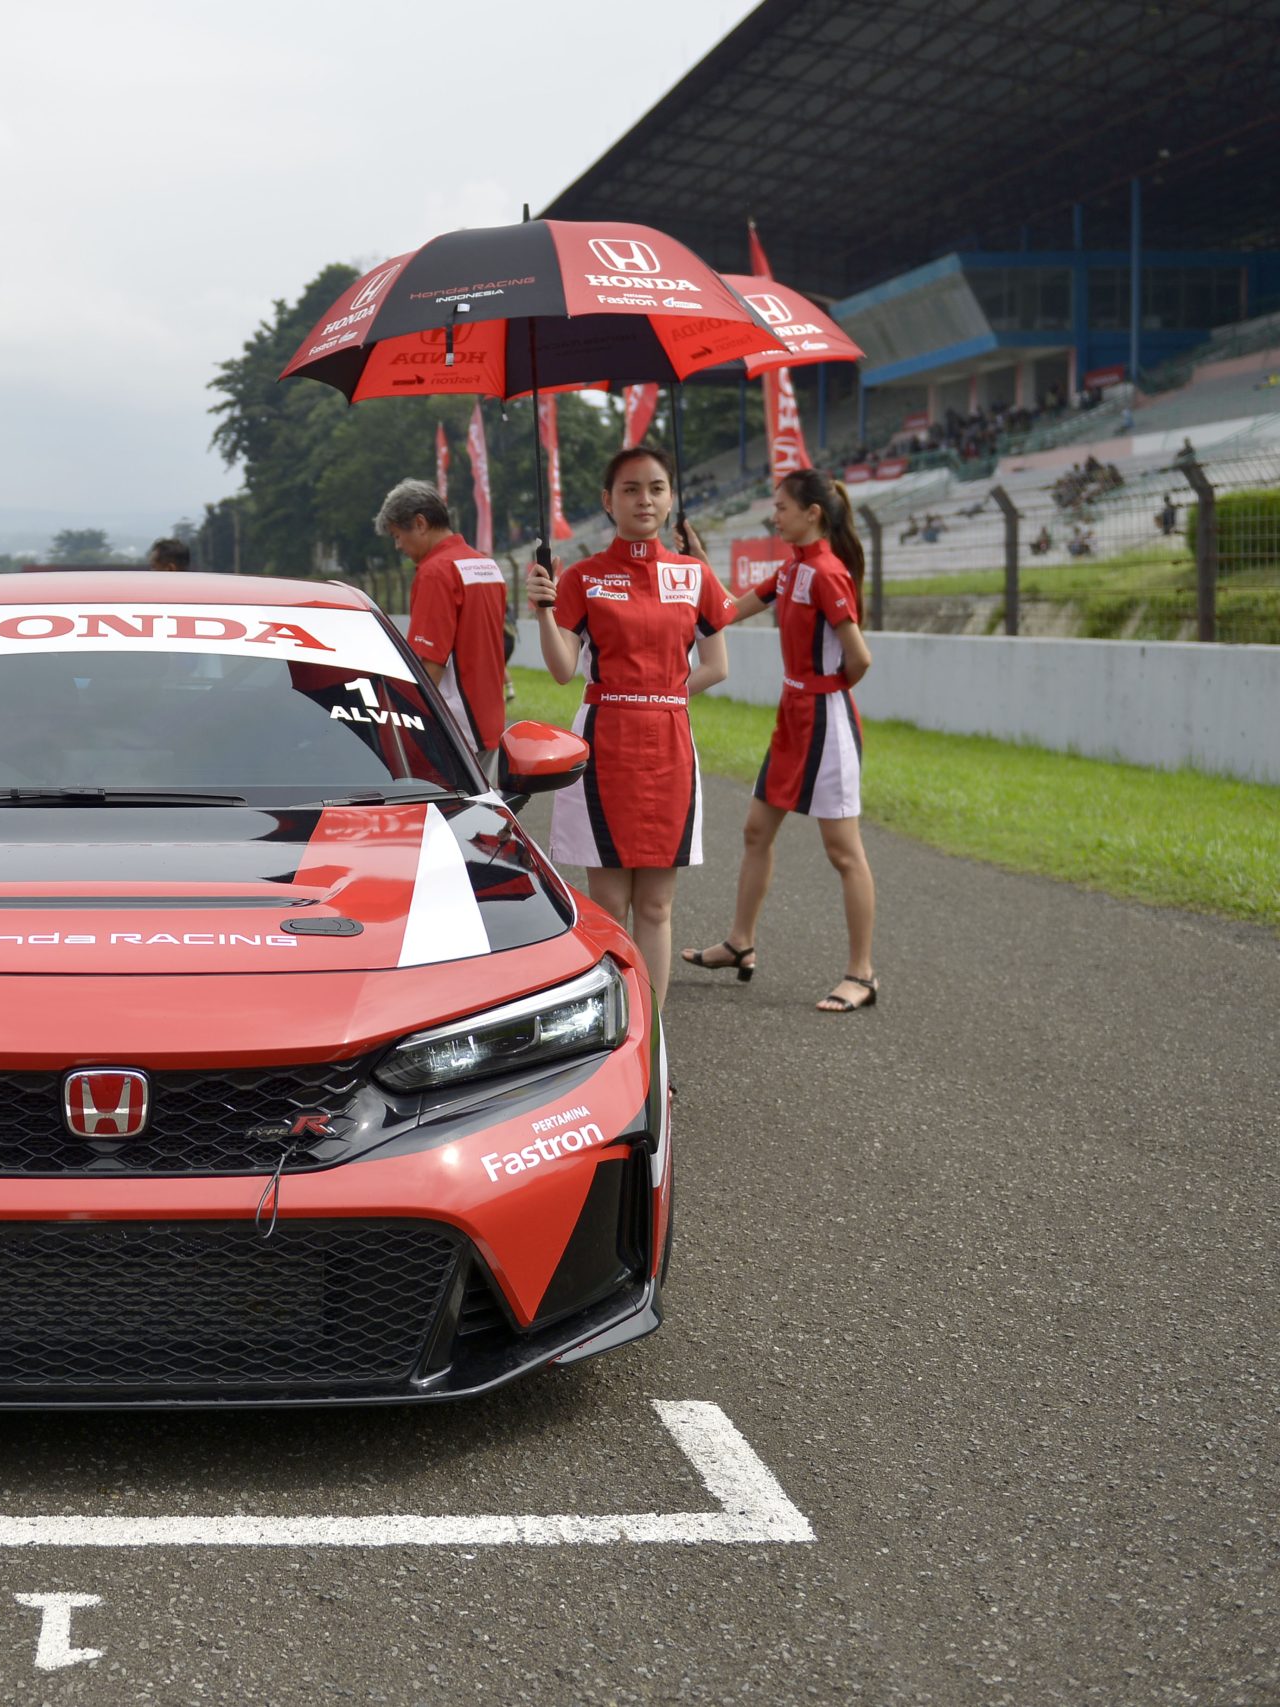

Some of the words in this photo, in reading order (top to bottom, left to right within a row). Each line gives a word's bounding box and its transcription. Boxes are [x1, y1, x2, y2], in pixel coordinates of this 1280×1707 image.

[409, 286, 470, 300] Honda
[472, 276, 536, 291] RACING
[584, 274, 702, 292] HONDA
[435, 288, 505, 303] INDONESIA
[596, 294, 658, 307] Fastron
[321, 303, 376, 336] HONDA
[582, 575, 631, 587] Fastron
[598, 591, 627, 600] WINCOS
[344, 677, 380, 708] 1
[600, 693, 647, 702] Honda
[649, 694, 686, 705] RACING
[329, 705, 425, 731] ALVIN
[110, 933, 298, 947] RACING
[531, 1105, 591, 1134] PERTAMINA
[480, 1122, 605, 1183] Fastron
